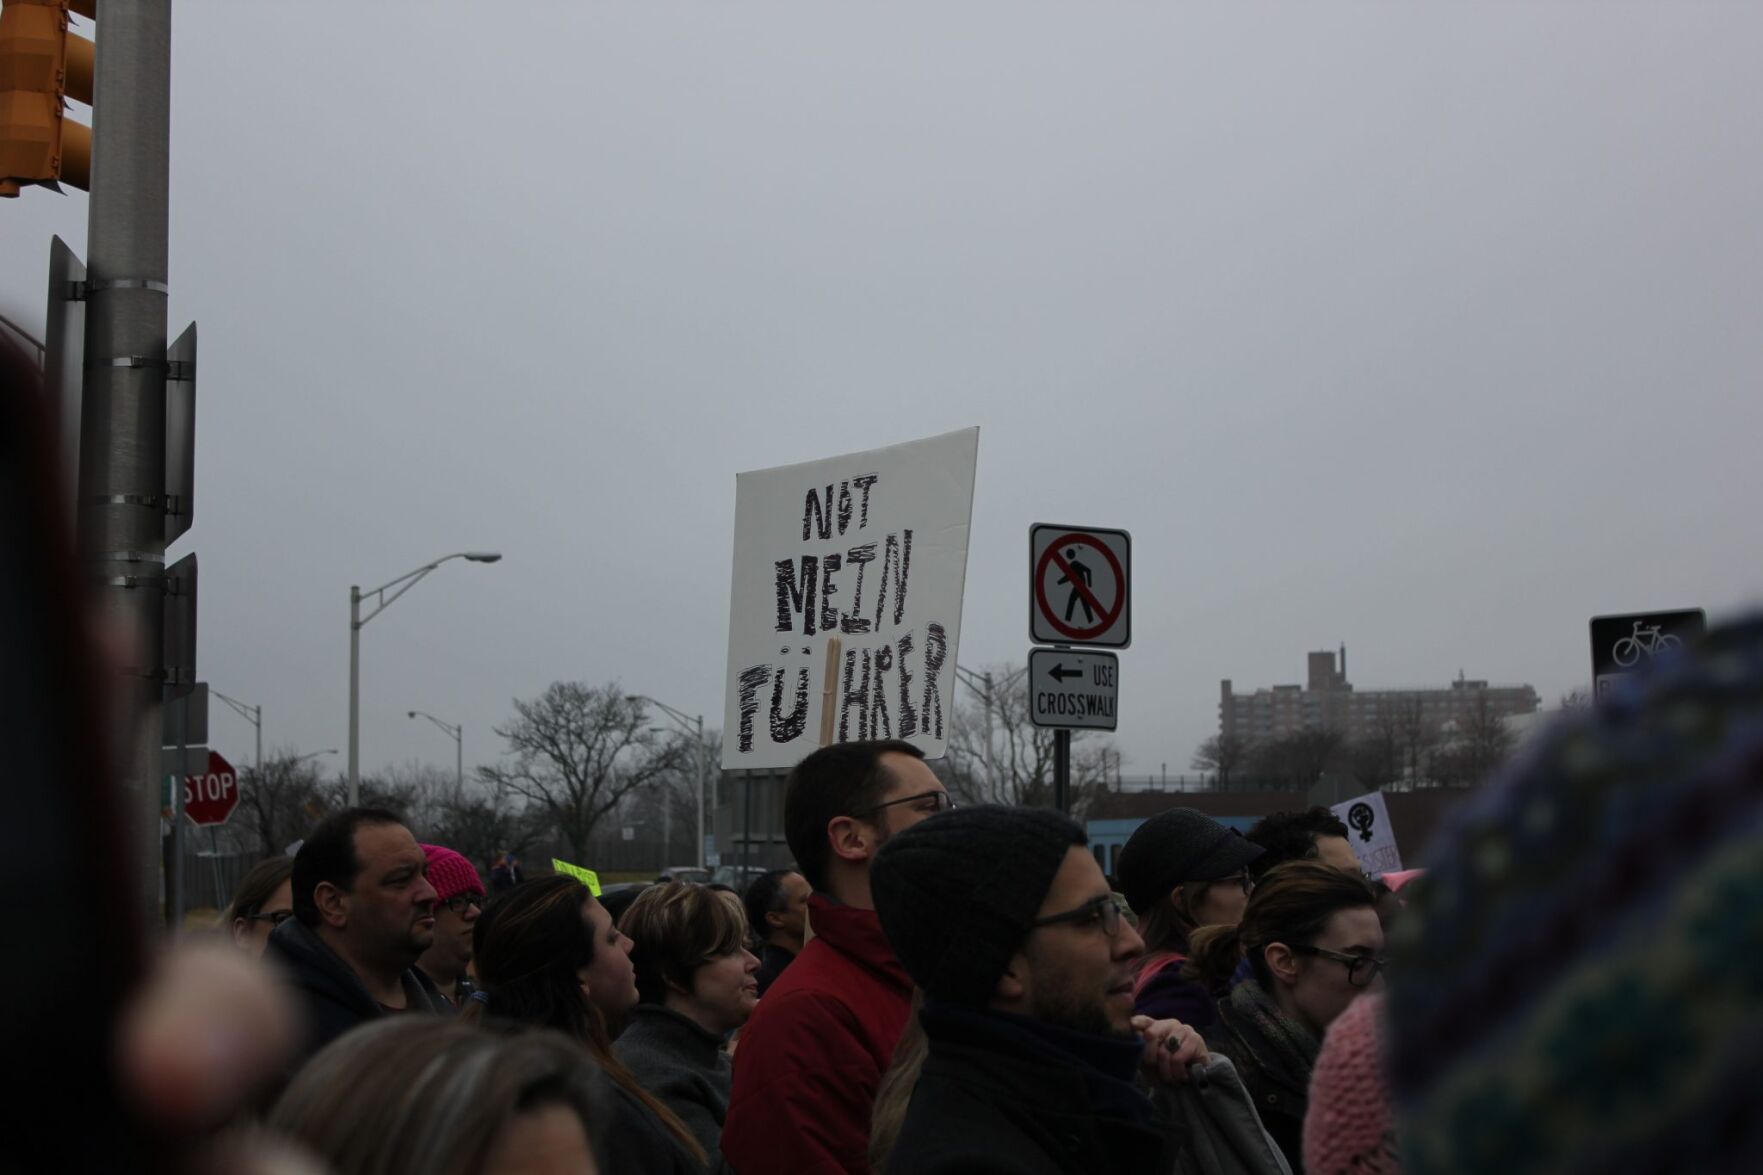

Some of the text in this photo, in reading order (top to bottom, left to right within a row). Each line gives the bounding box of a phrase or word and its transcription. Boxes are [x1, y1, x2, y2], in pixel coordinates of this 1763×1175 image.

[802, 473, 878, 541] NOT
[775, 529, 913, 635] MEIN
[1094, 665, 1113, 686] USE
[1038, 692, 1114, 717] CROSSWALK
